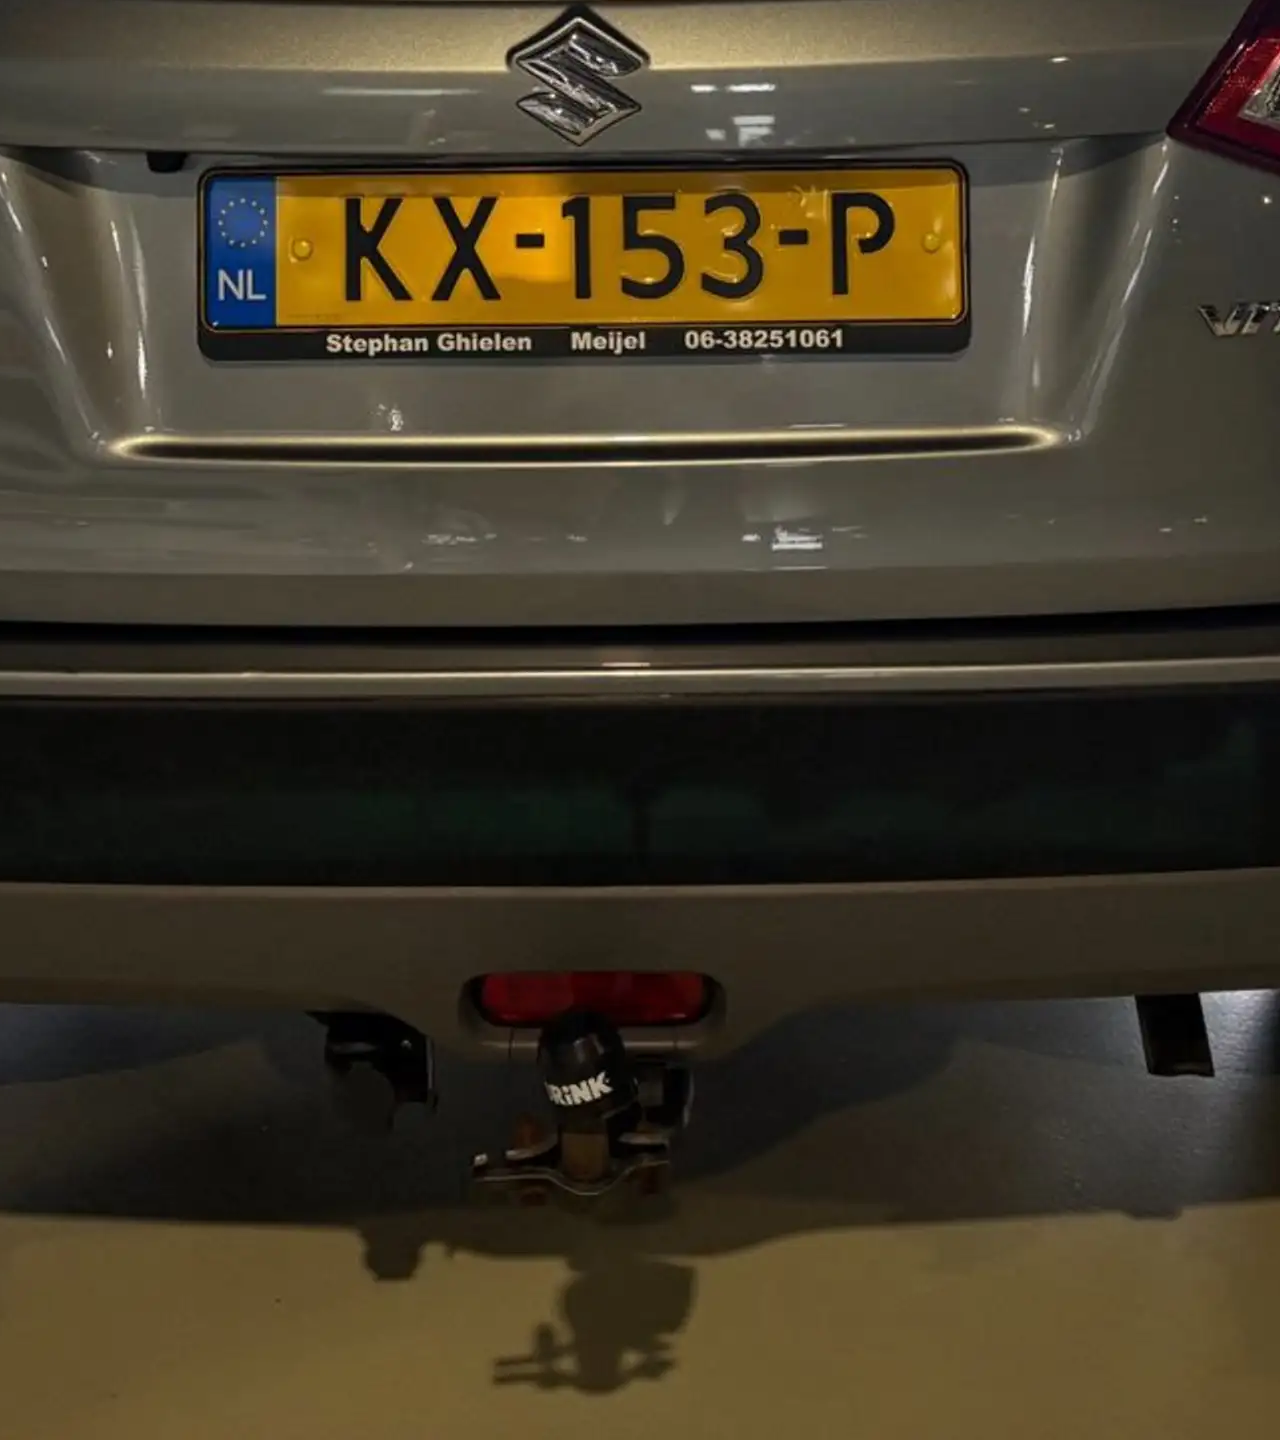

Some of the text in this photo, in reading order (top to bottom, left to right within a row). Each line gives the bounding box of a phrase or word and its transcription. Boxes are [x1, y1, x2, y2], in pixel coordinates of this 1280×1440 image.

[343, 191, 895, 302] KX-153-P
[218, 269, 267, 301] NL
[326, 329, 844, 356] Stephan Ghielen Meijel 06-38251061
